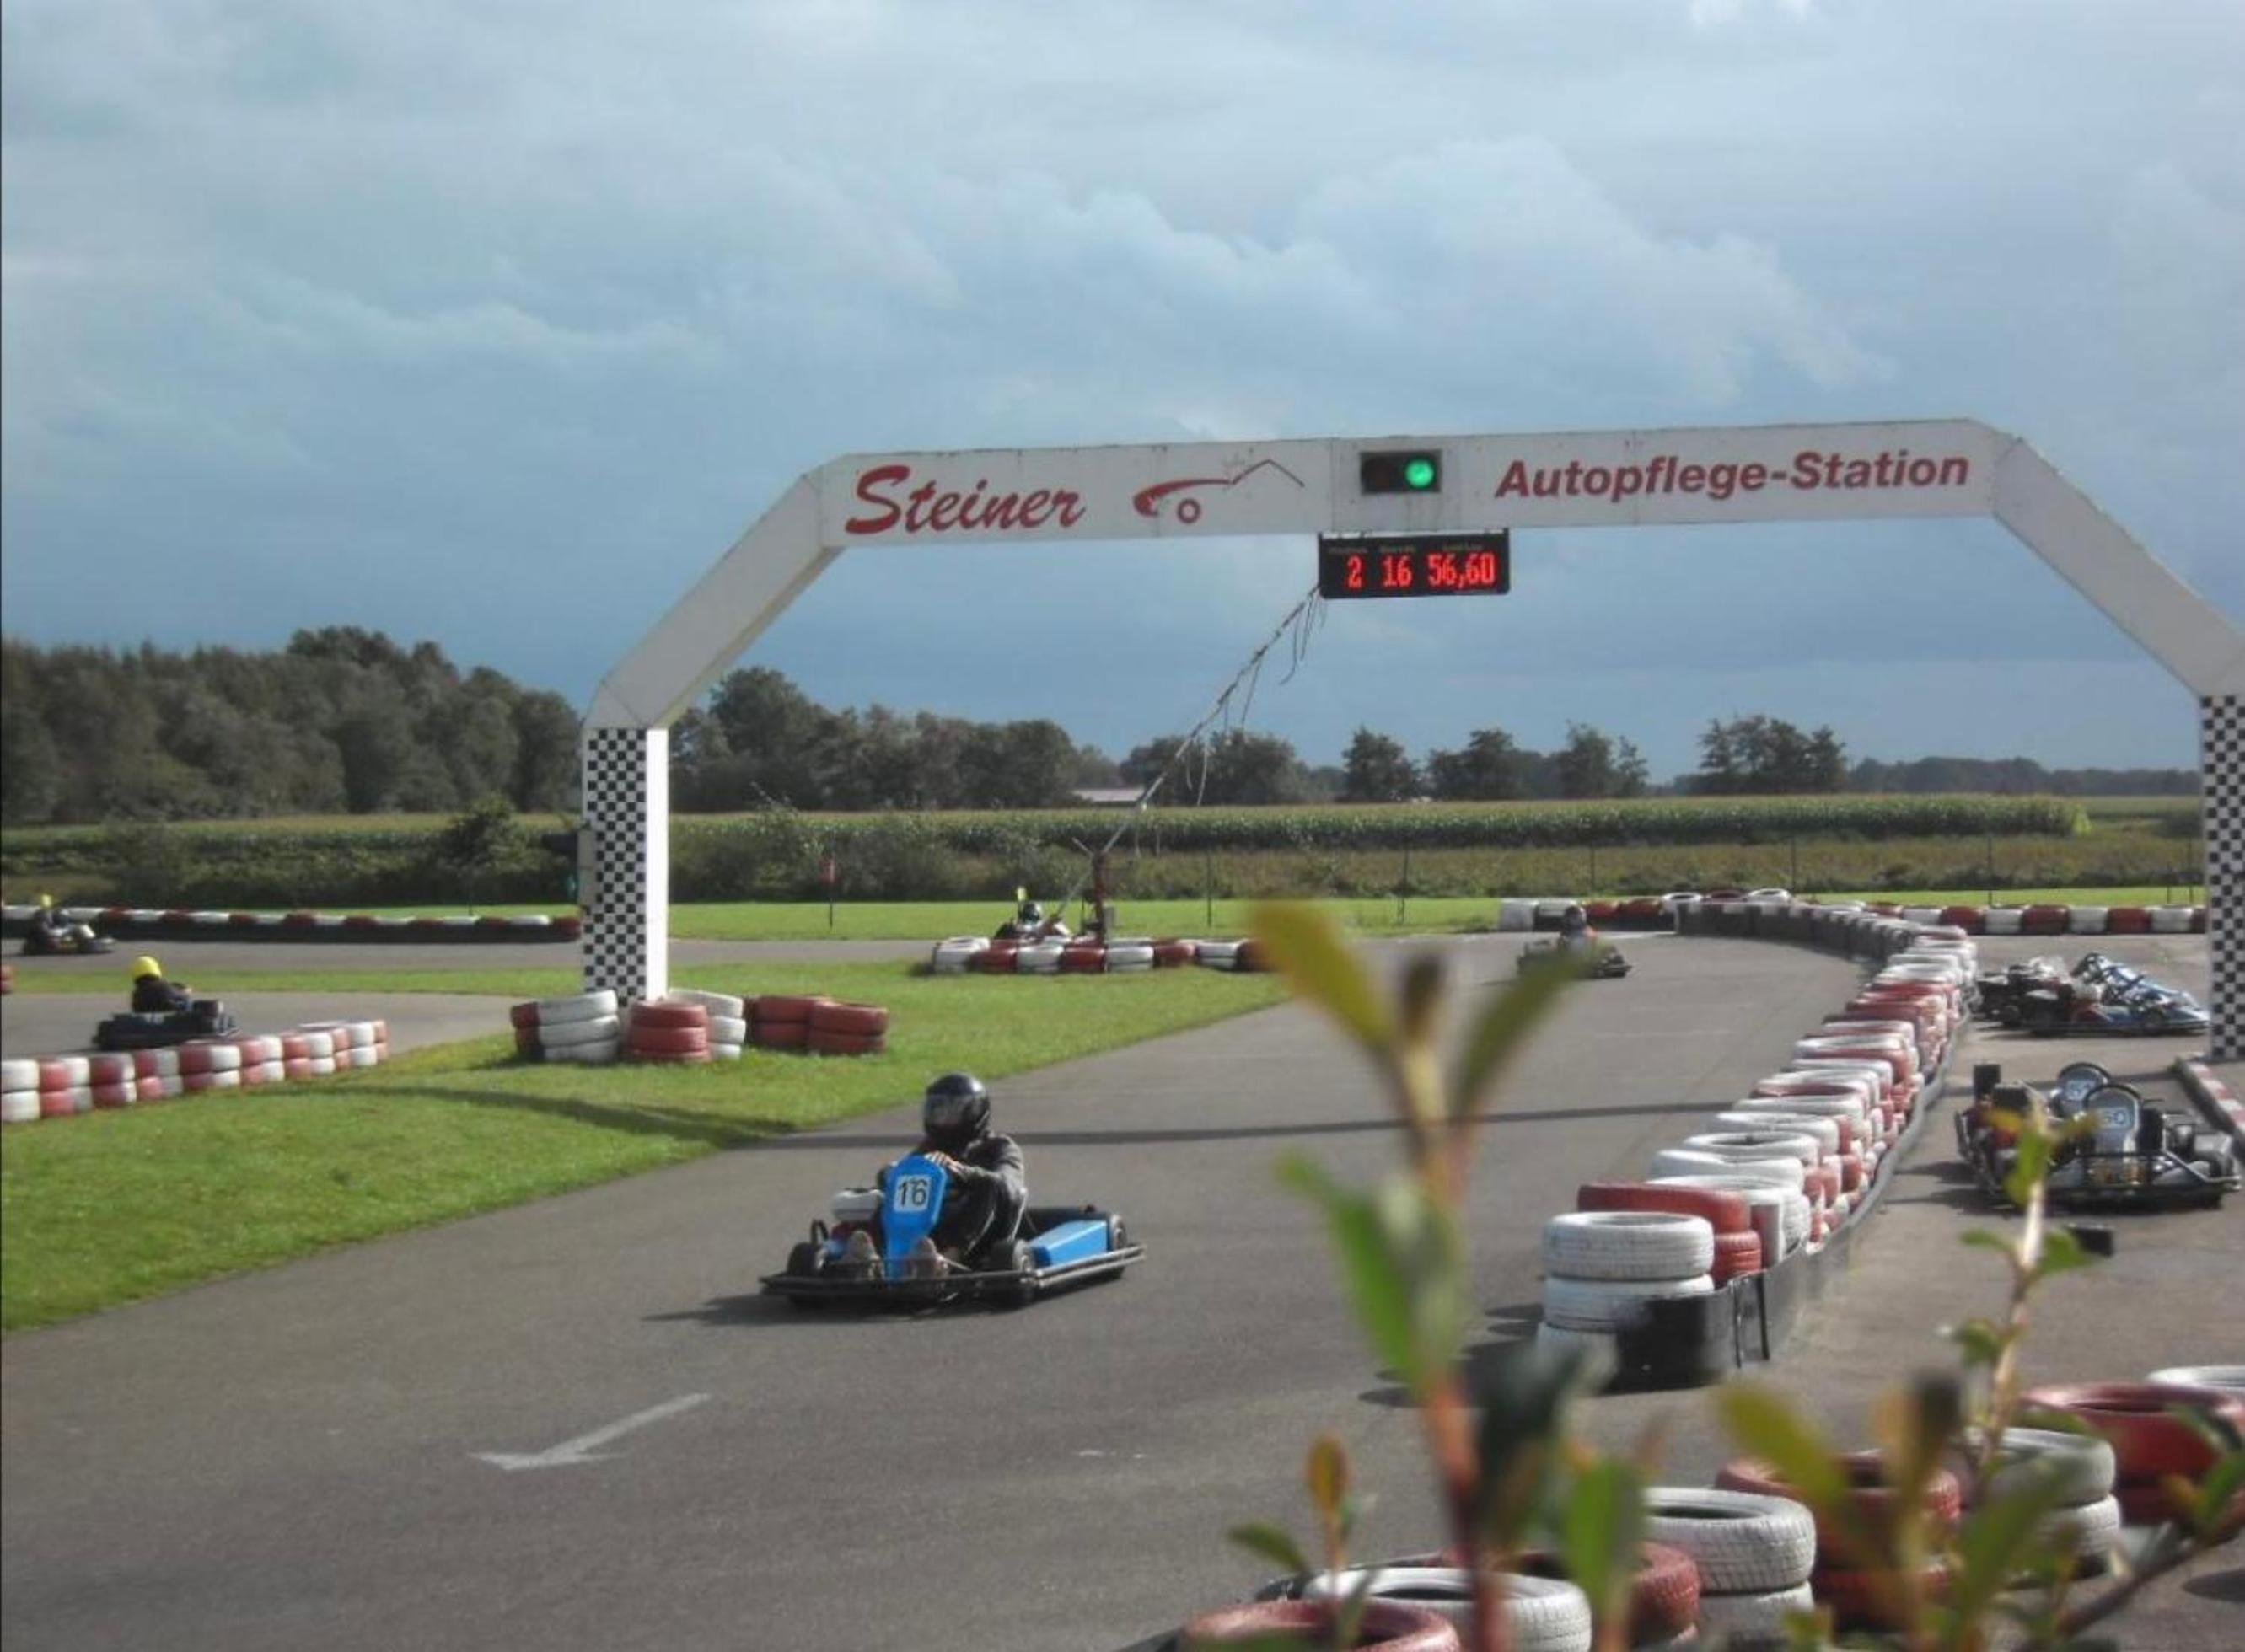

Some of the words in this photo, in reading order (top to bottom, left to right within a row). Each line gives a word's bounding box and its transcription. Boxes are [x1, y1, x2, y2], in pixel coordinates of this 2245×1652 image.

[845, 464, 1085, 534] Steiner
[1495, 450, 1970, 503] Autopflege-Station
[1346, 554, 1364, 588] 2
[1383, 554, 1413, 587] 16
[1426, 551, 1498, 589] 56,60
[898, 1178, 928, 1208] 16
